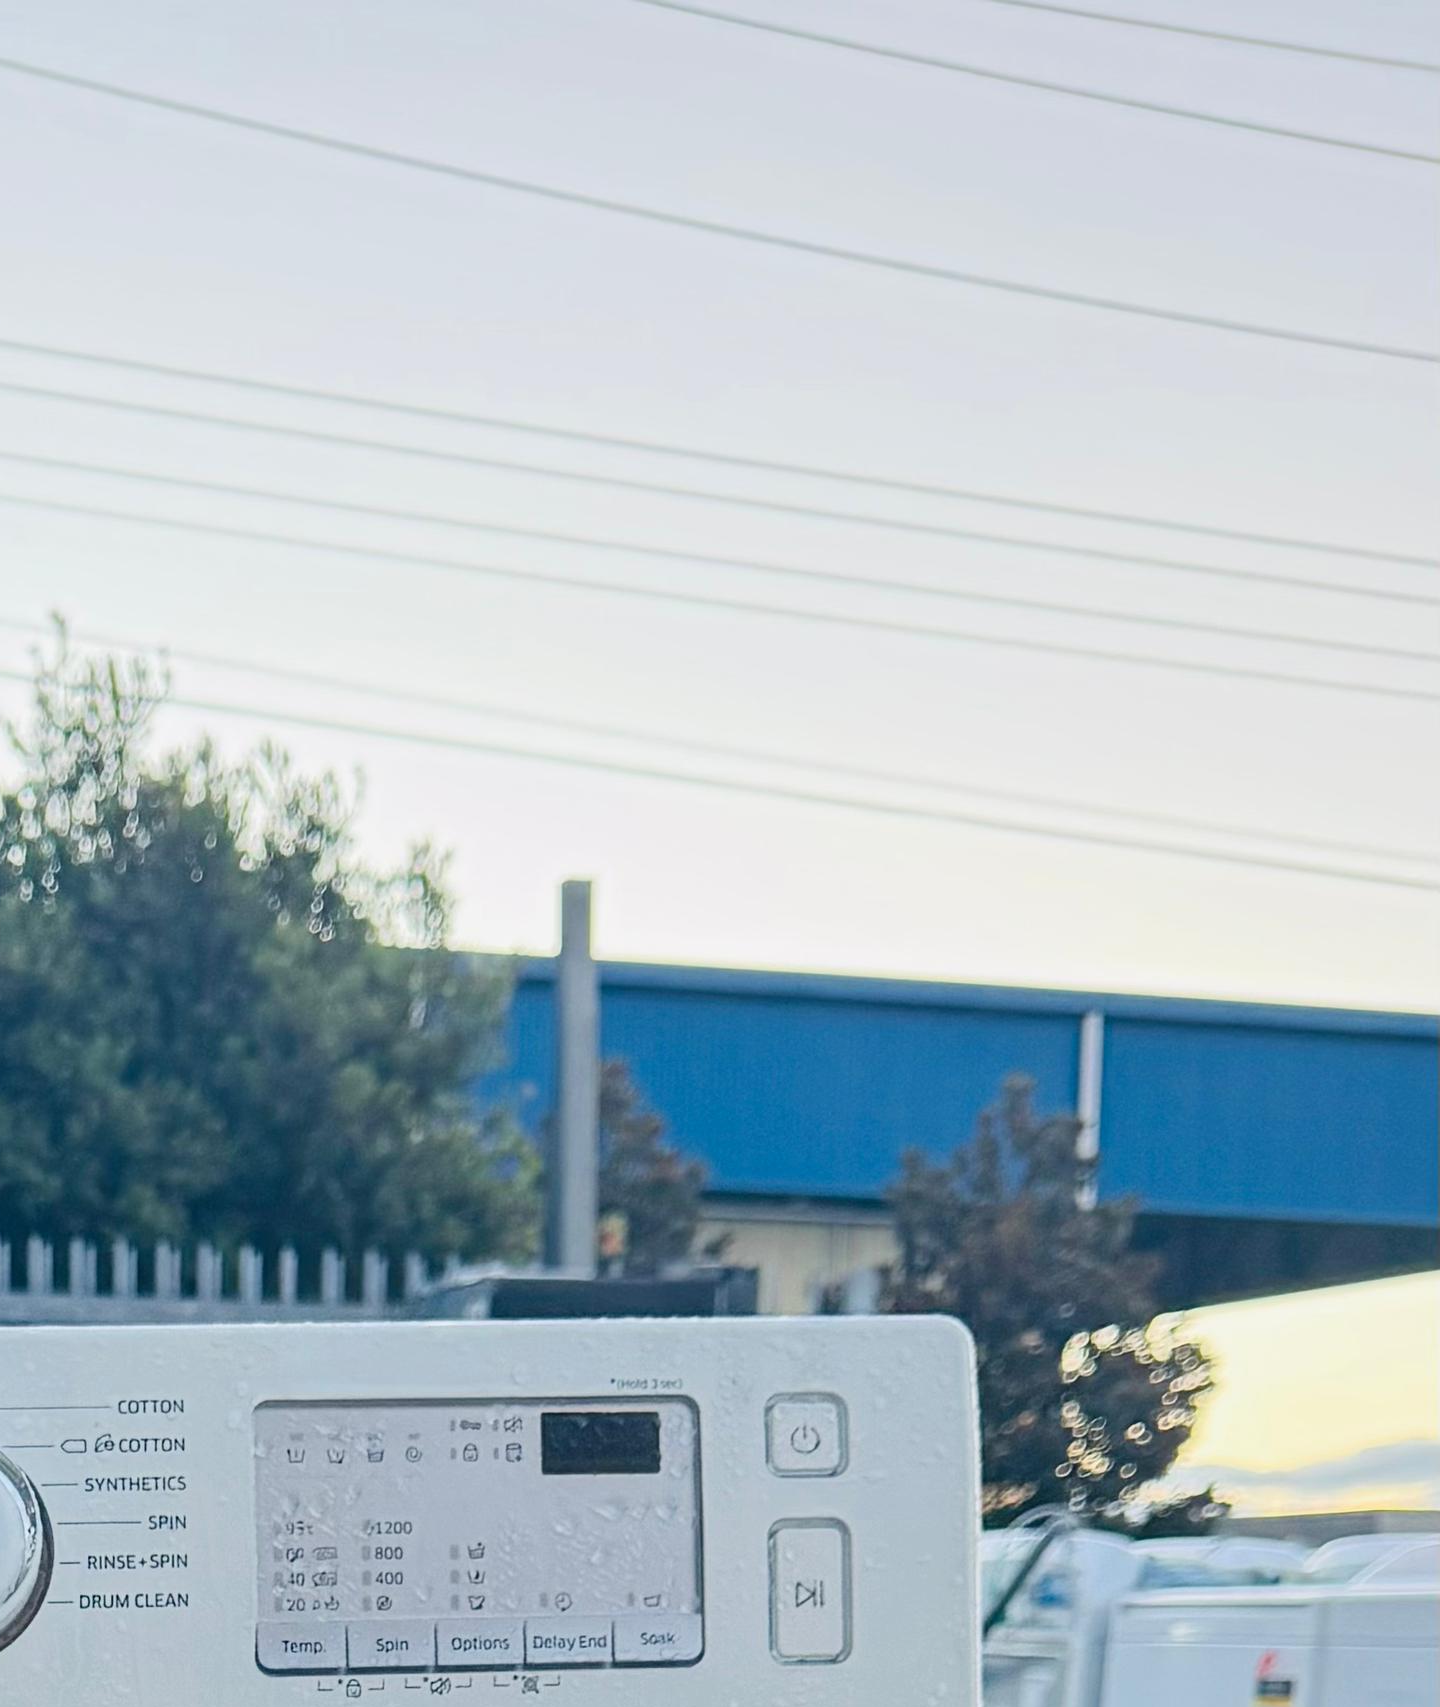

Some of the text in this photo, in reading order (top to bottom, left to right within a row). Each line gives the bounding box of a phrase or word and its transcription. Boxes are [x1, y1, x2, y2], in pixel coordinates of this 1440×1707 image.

[118, 1399, 185, 1414] COTTON
[119, 1438, 185, 1453] COTTON
[85, 1476, 187, 1492] SYNTHETICS
[148, 1515, 187, 1530] SPIN
[376, 1521, 413, 1535] 1200
[374, 1546, 404, 1561] 800
[375, 1571, 404, 1586] 400
[79, 1593, 189, 1609] DRUM CLEAN
[287, 1598, 306, 1612] 20
[376, 1637, 409, 1654] Spin
[451, 1635, 510, 1652] Options
[533, 1633, 608, 1652] Delay End
[640, 1631, 677, 1646] Soak
